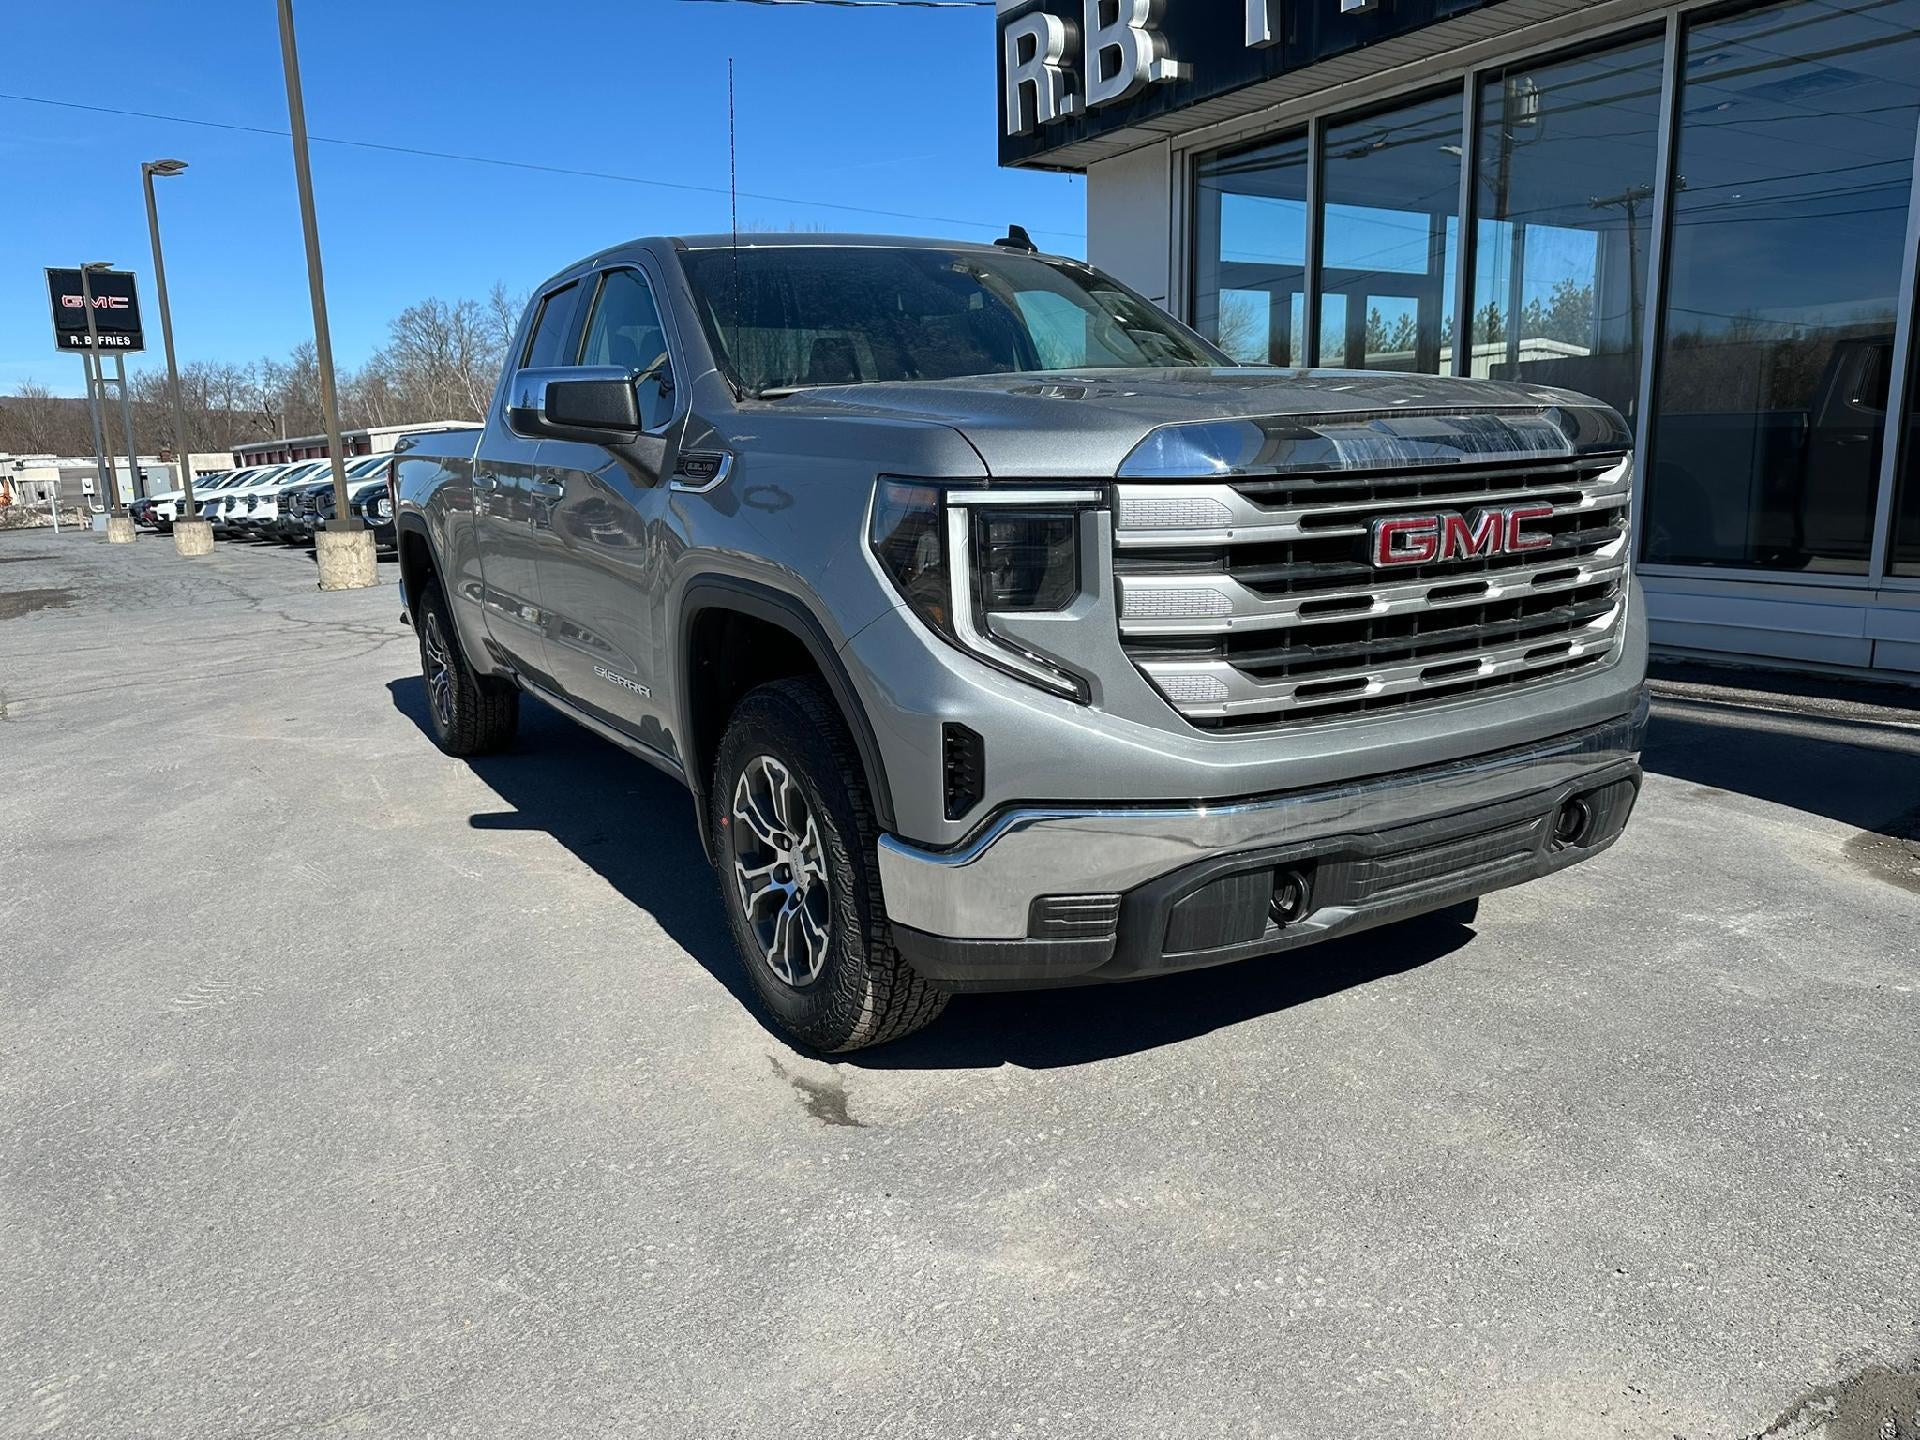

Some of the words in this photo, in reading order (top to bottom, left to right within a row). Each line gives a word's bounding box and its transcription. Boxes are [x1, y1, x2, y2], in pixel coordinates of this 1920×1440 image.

[98, 336, 130, 345] FRIES
[1373, 502, 1554, 568] GMC
[594, 665, 652, 698] SIERRA
